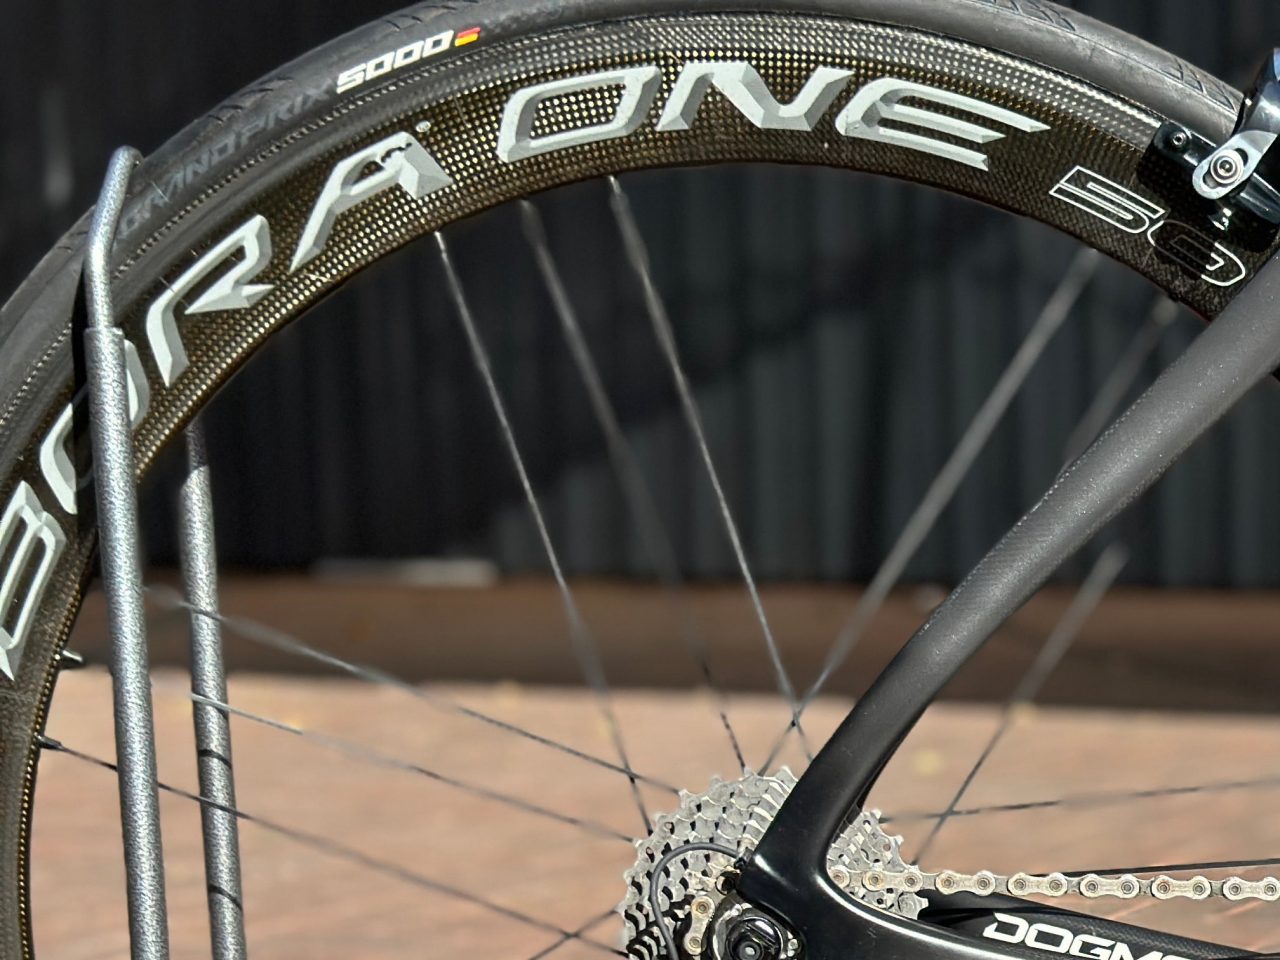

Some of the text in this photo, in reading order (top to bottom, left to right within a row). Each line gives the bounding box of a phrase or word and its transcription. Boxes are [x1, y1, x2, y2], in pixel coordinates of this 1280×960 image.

[335, 30, 455, 94] 5000
[497, 62, 1051, 171] ONE
[1049, 165, 1246, 287] 50
